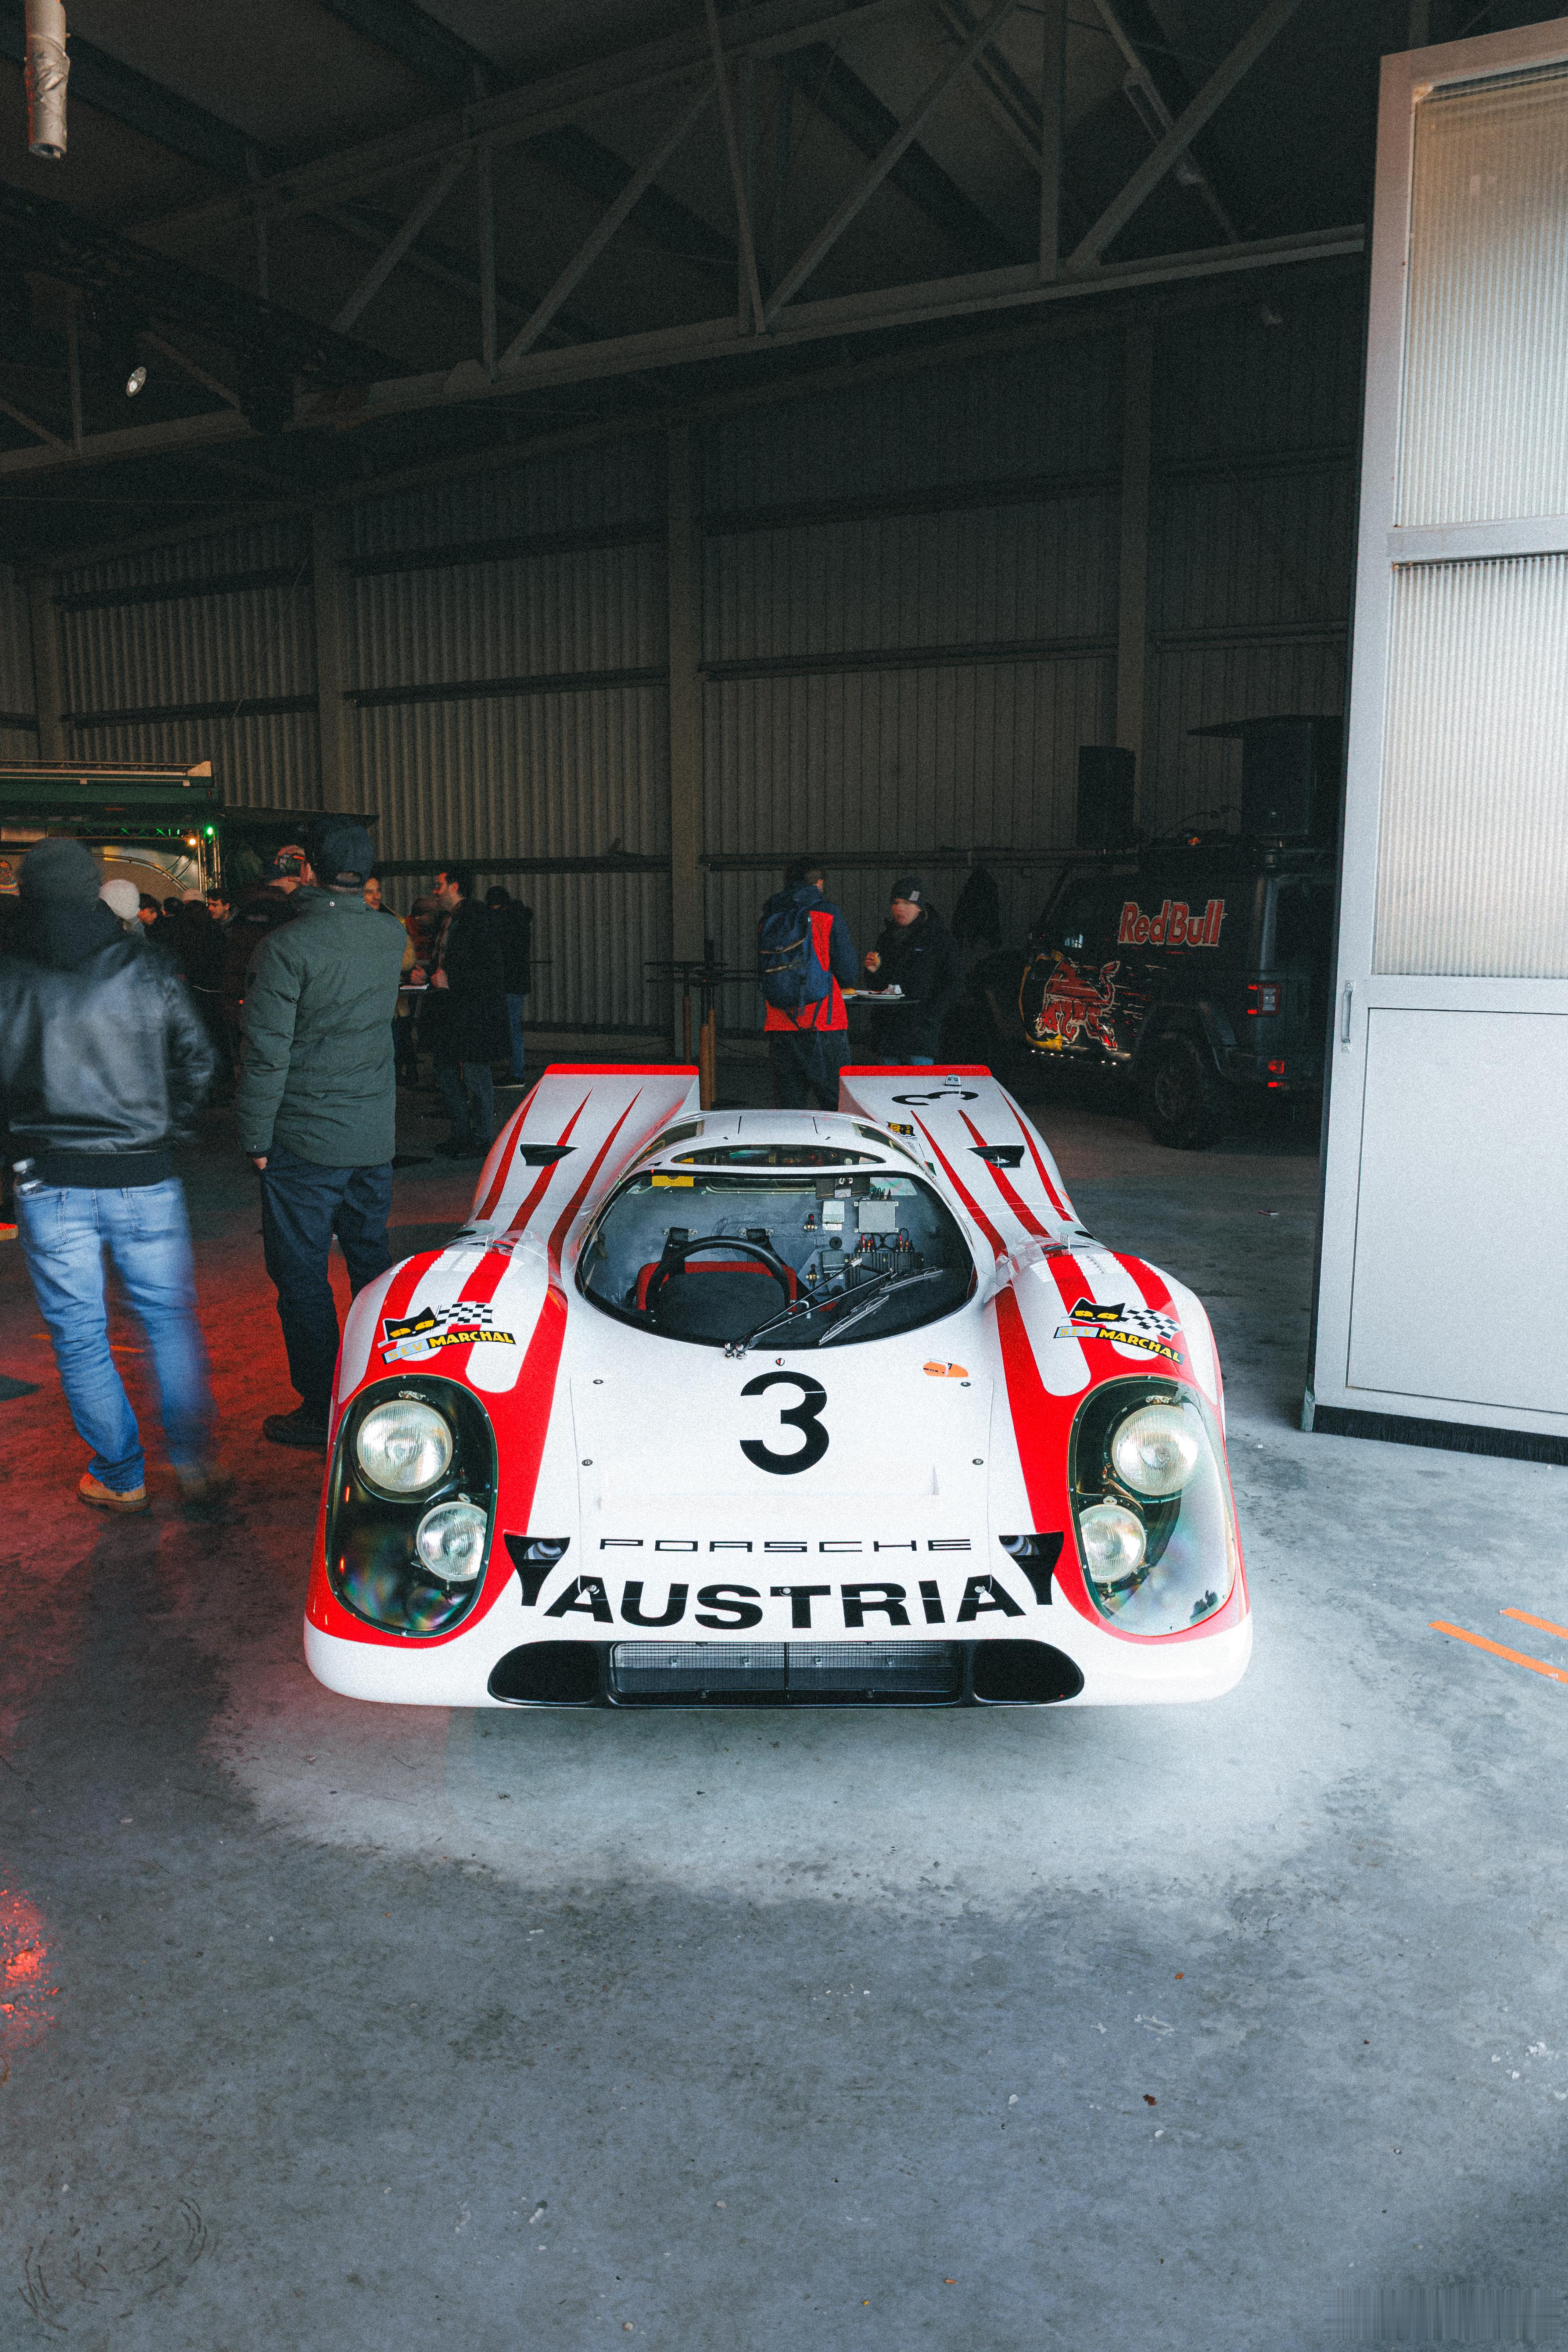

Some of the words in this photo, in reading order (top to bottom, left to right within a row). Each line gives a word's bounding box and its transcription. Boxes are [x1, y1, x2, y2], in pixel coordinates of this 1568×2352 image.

[891, 1090, 979, 1106] 3
[429, 1331, 514, 1347] MARCHAL
[1099, 1329, 1180, 1362] MARCHAL
[739, 1371, 829, 1475] 3
[600, 1538, 971, 1553] PORSCHE
[544, 1575, 1026, 1630] AUSTRIA
